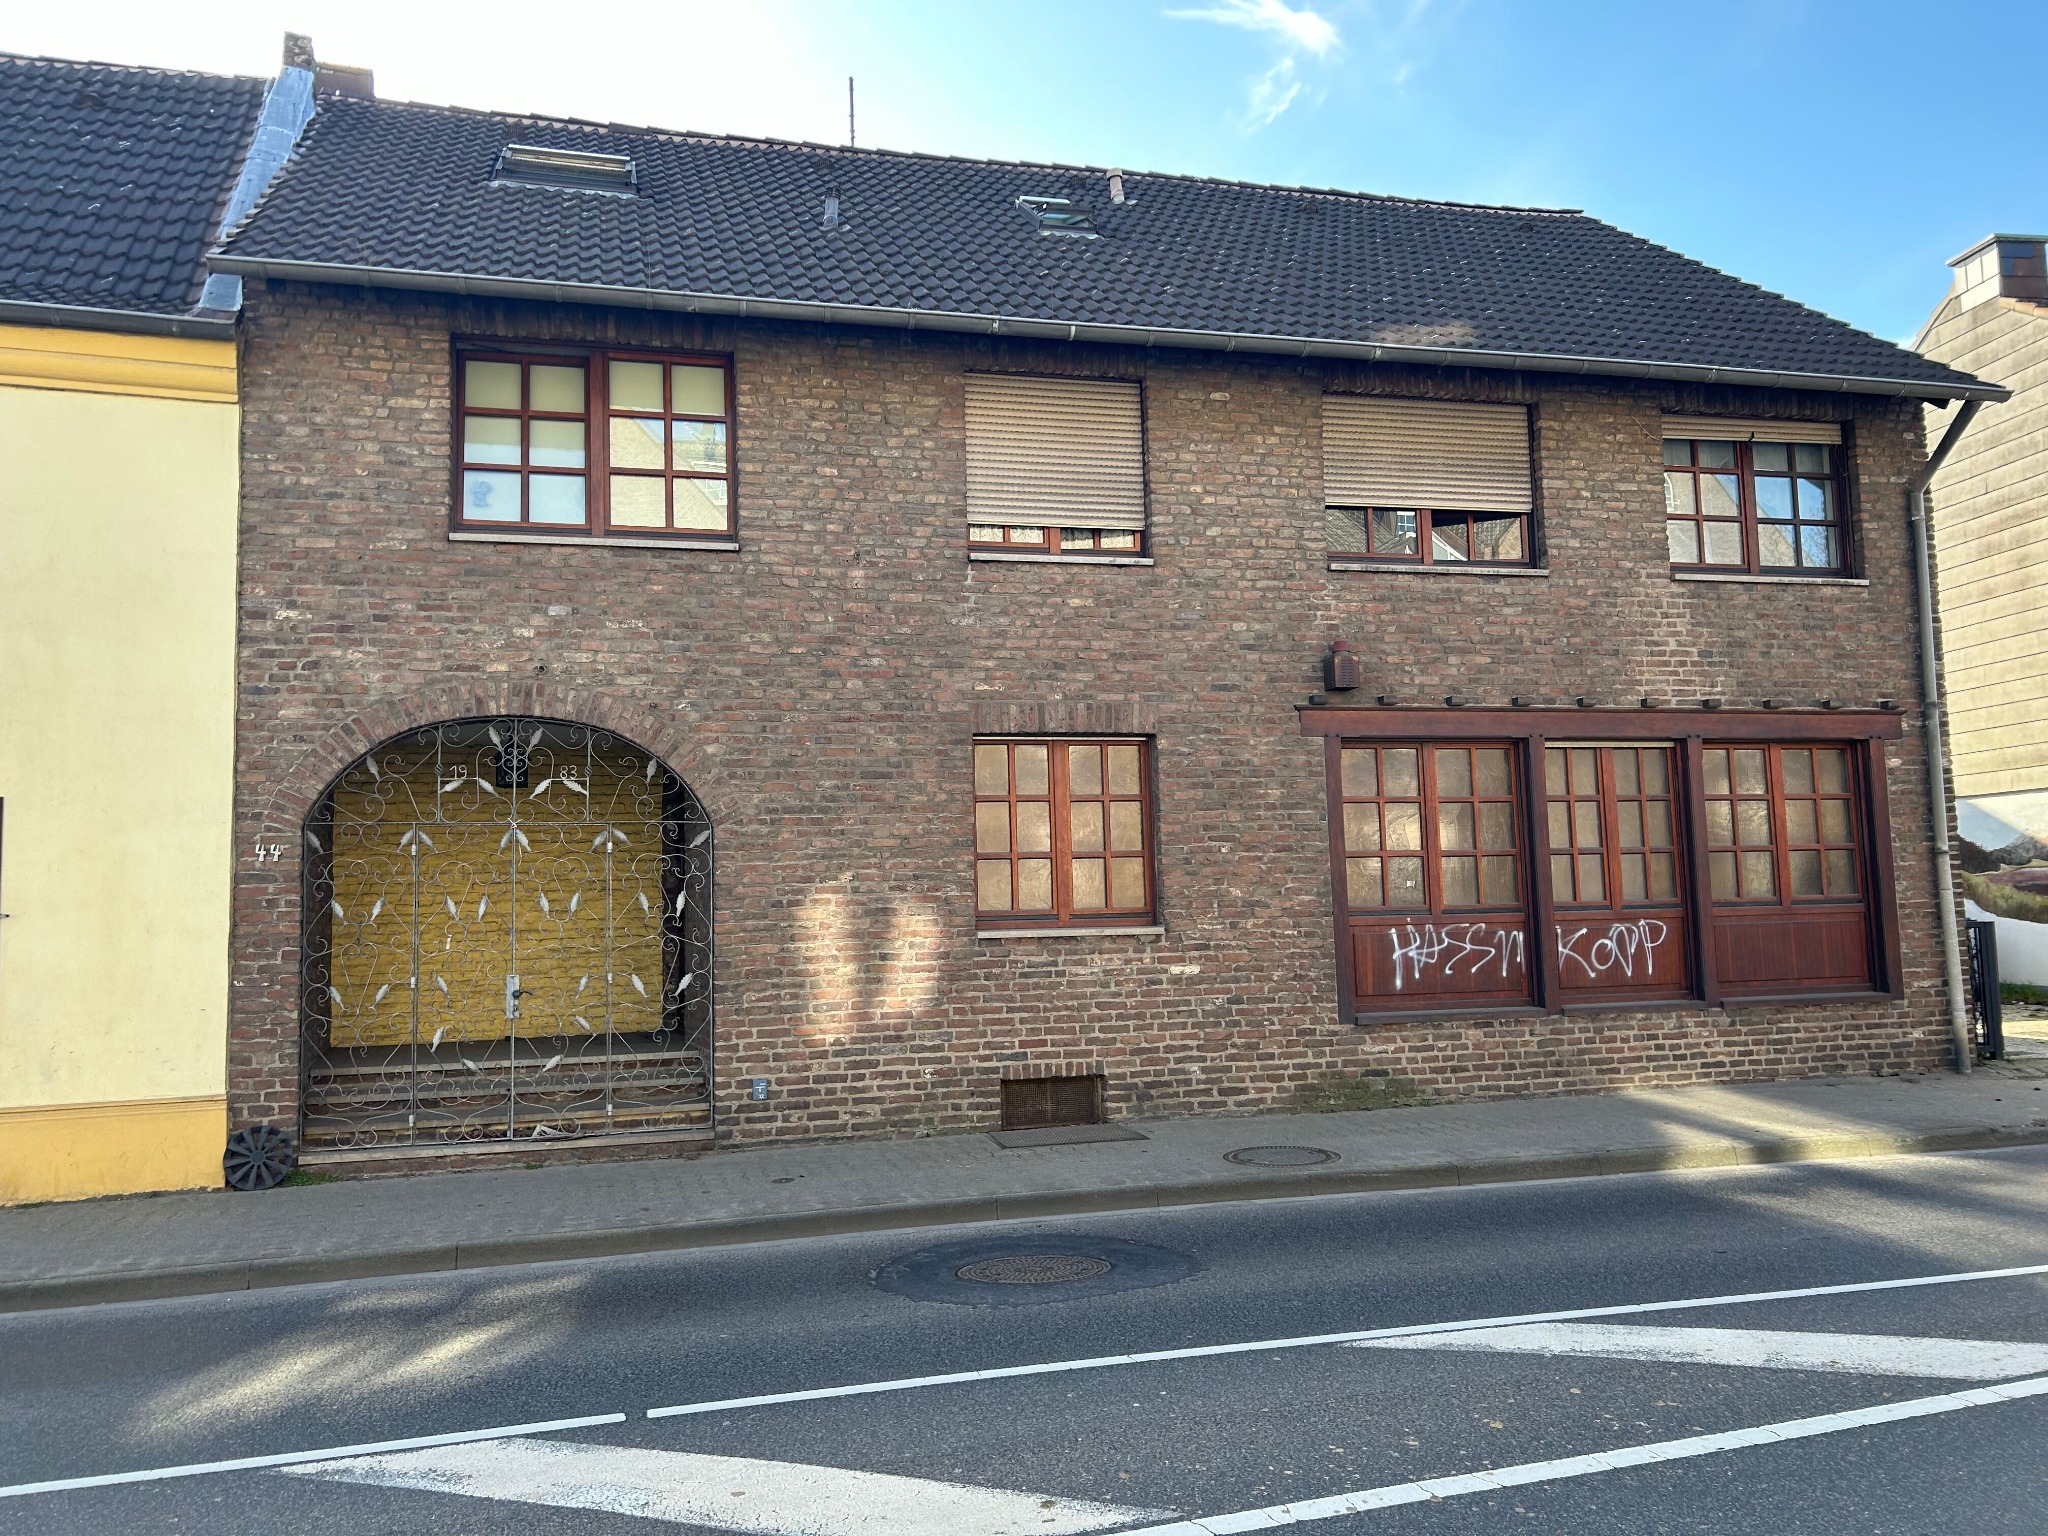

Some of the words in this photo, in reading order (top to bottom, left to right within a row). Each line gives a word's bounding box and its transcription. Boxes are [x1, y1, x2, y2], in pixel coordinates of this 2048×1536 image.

[449, 764, 468, 780] 19
[560, 765, 578, 780] 83
[255, 843, 282, 862] 44
